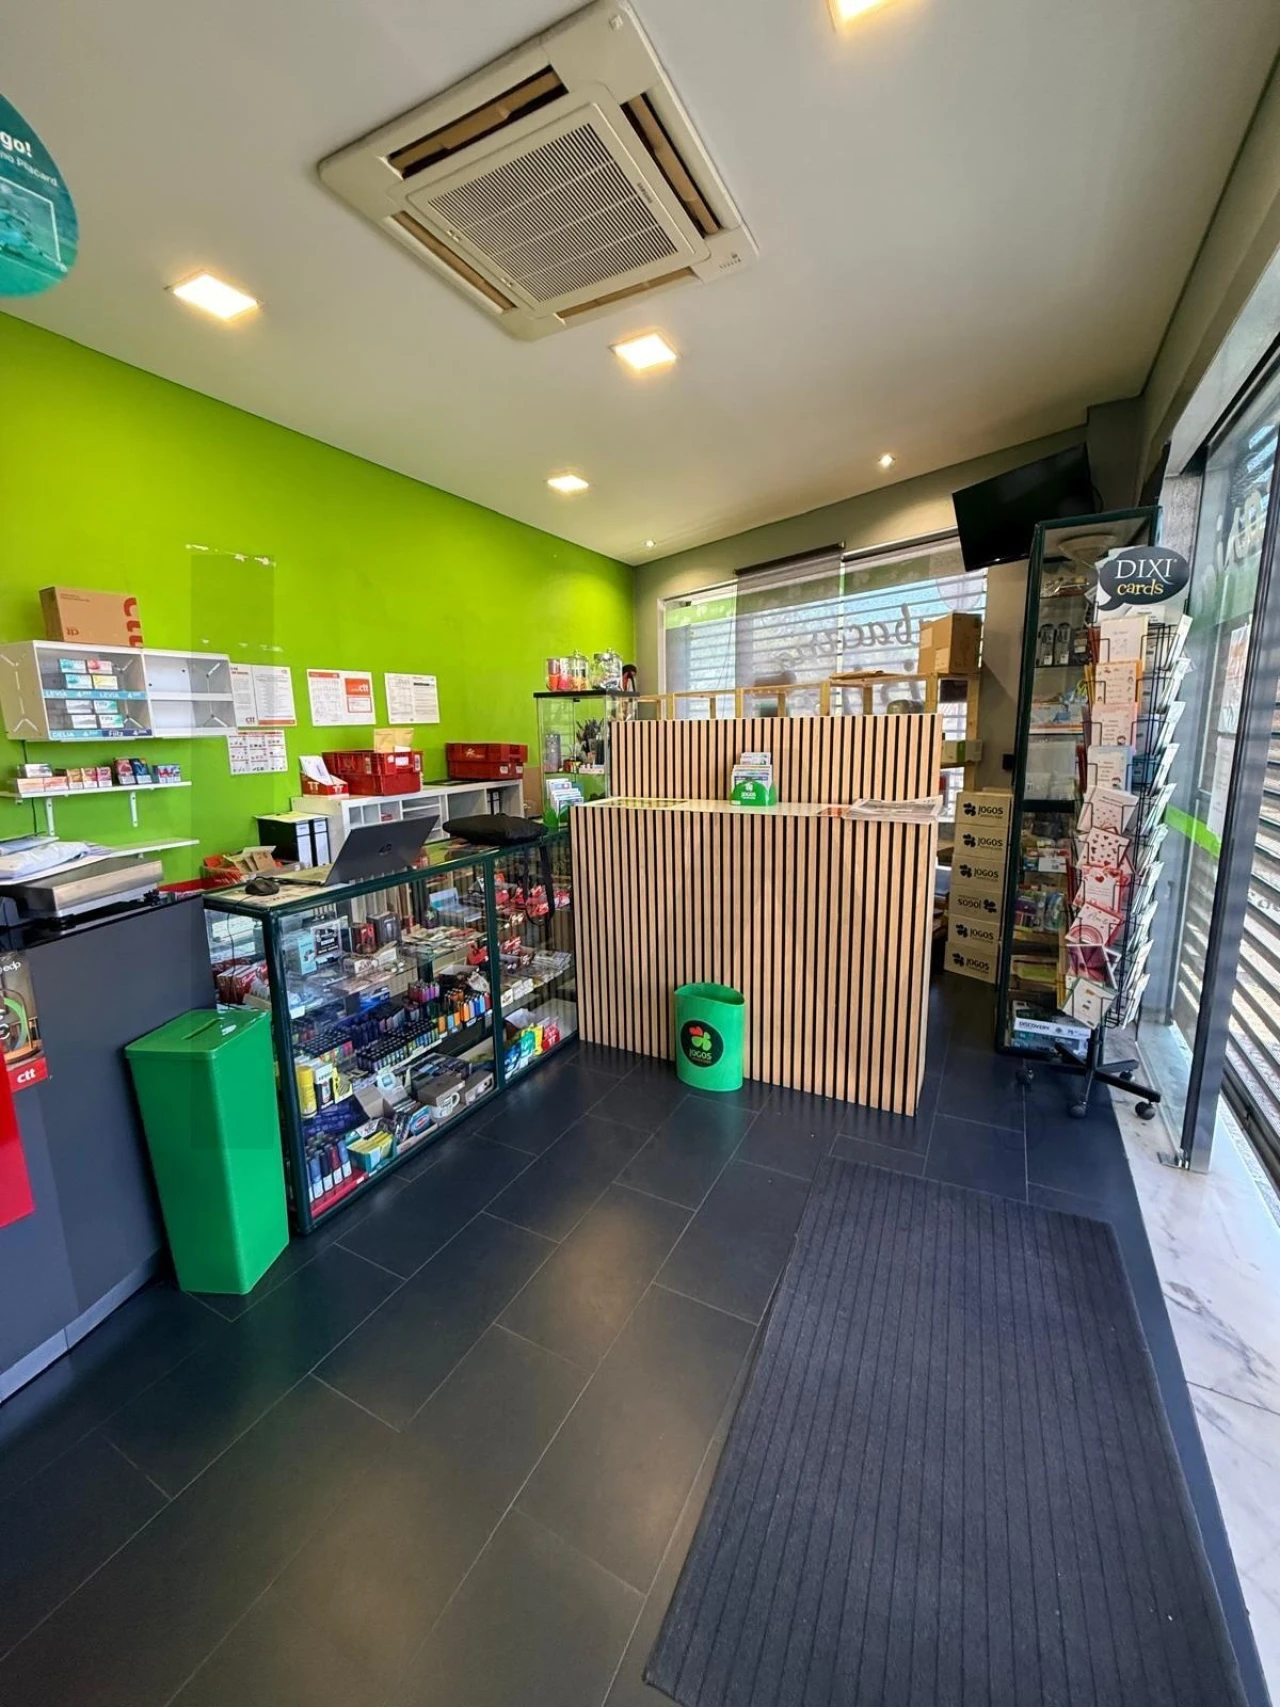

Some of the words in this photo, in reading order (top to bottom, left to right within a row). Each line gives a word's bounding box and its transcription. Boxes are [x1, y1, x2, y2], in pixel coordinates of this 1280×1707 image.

[1114, 558, 1174, 585] DIXI
[1117, 579, 1164, 595] cards
[978, 804, 1004, 815] JOGOS
[977, 836, 1003, 847] JOGOS
[974, 867, 999, 878] JOGOS
[958, 899, 982, 909] JOGOS
[969, 929, 994, 940] JOGOS
[3, 960, 21, 971] edp
[966, 957, 990, 970] JOGOS
[689, 1048, 712, 1059] JOGOS
[17, 1068, 36, 1083] ctt
